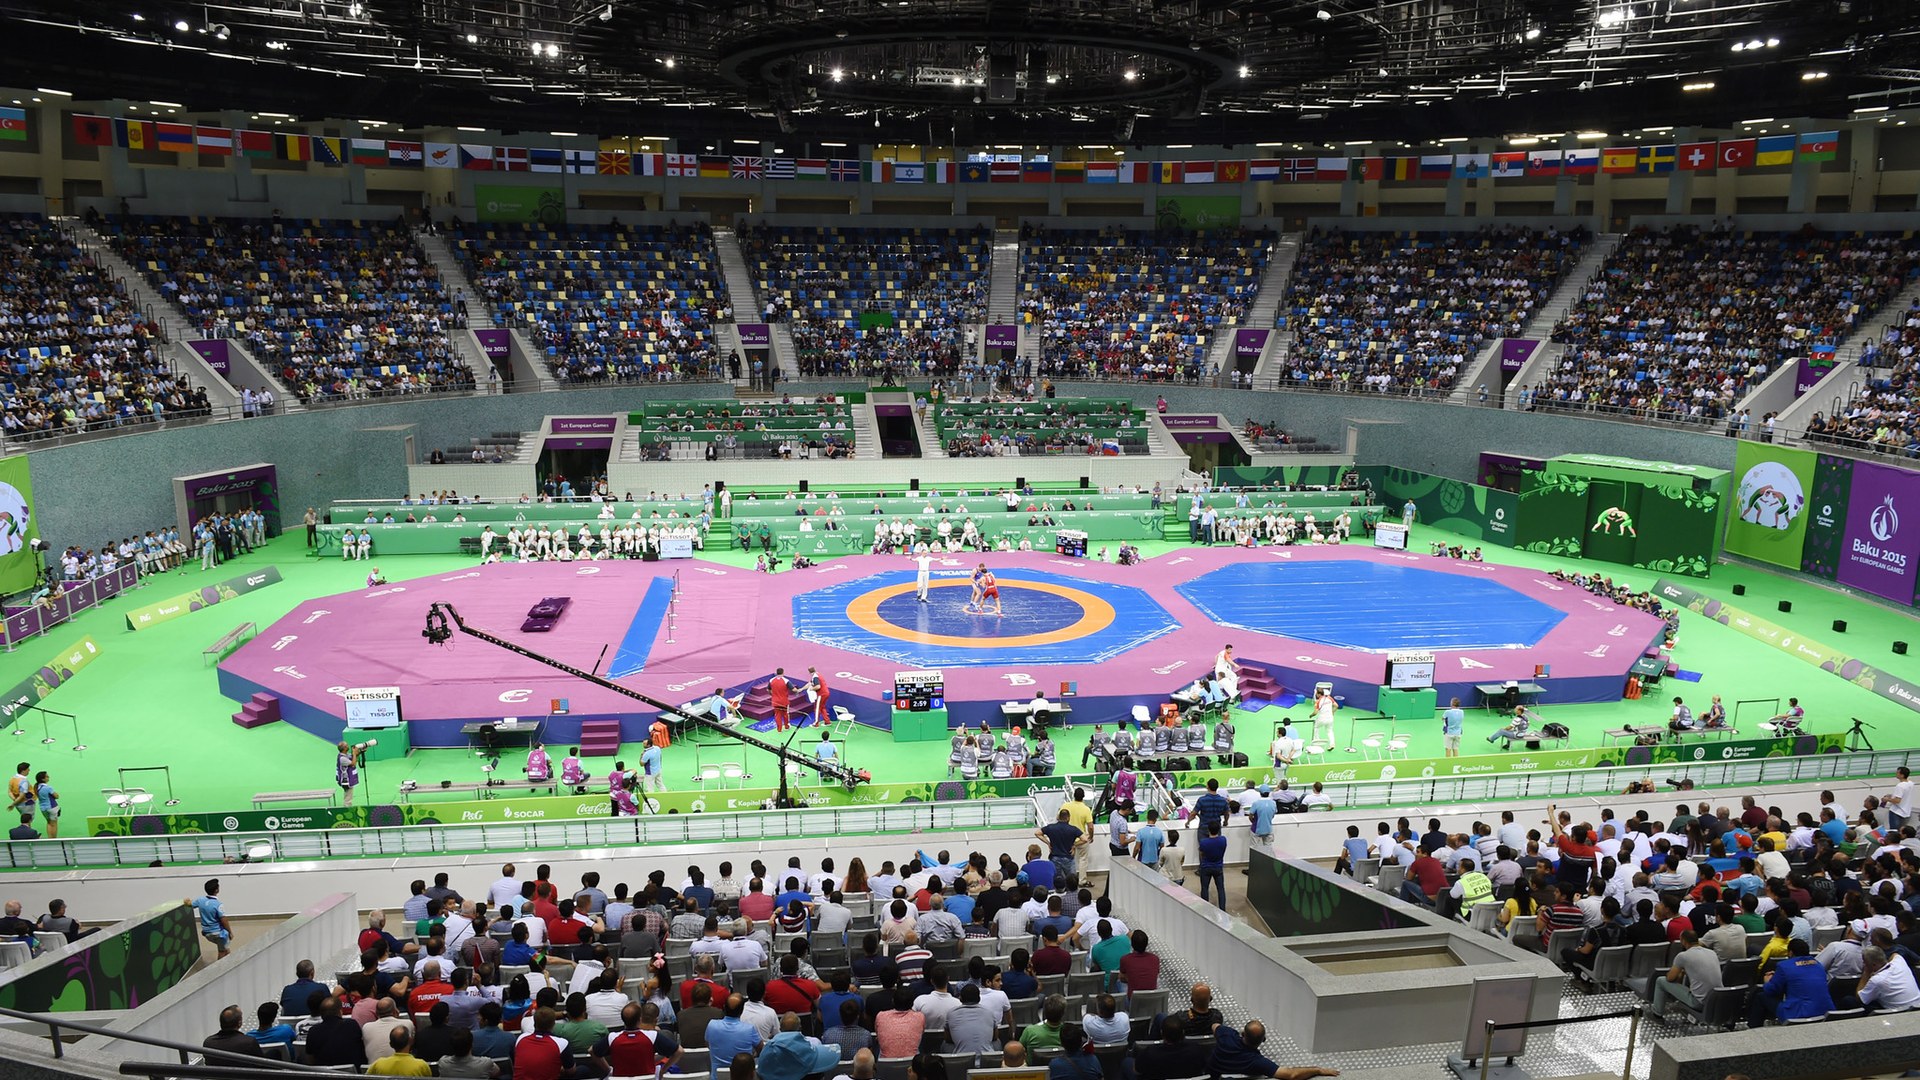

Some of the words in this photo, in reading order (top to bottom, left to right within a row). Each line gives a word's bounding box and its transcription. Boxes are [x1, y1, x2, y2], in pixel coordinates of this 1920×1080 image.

[196, 484, 228, 496] Baku
[229, 479, 256, 490] 2015
[1852, 538, 1880, 557] Baku
[1881, 550, 1906, 567] 2015
[1859, 556, 1886, 569] EUROPEAN
[1886, 565, 1904, 575] GAMES
[1458, 657, 1494, 669] A
[999, 673, 1036, 686] B
[360, 692, 394, 700] TISSOT
[498, 689, 533, 703] C
[1896, 688, 1912, 700] Baku
[900, 700, 906, 708] 0
[934, 698, 940, 707] 0
[1510, 762, 1539, 770] TISSOT
[1555, 759, 1574, 767] AZAL
[1227, 777, 1246, 787] P&G
[1272, 777, 1298, 785] SAR
[1325, 769, 1357, 781] Coca-Cola
[462, 810, 484, 821] P&G
[514, 810, 544, 818] SOCAR
[738, 799, 761, 807] Kapital
[1473, 883, 1491, 895] FHN
